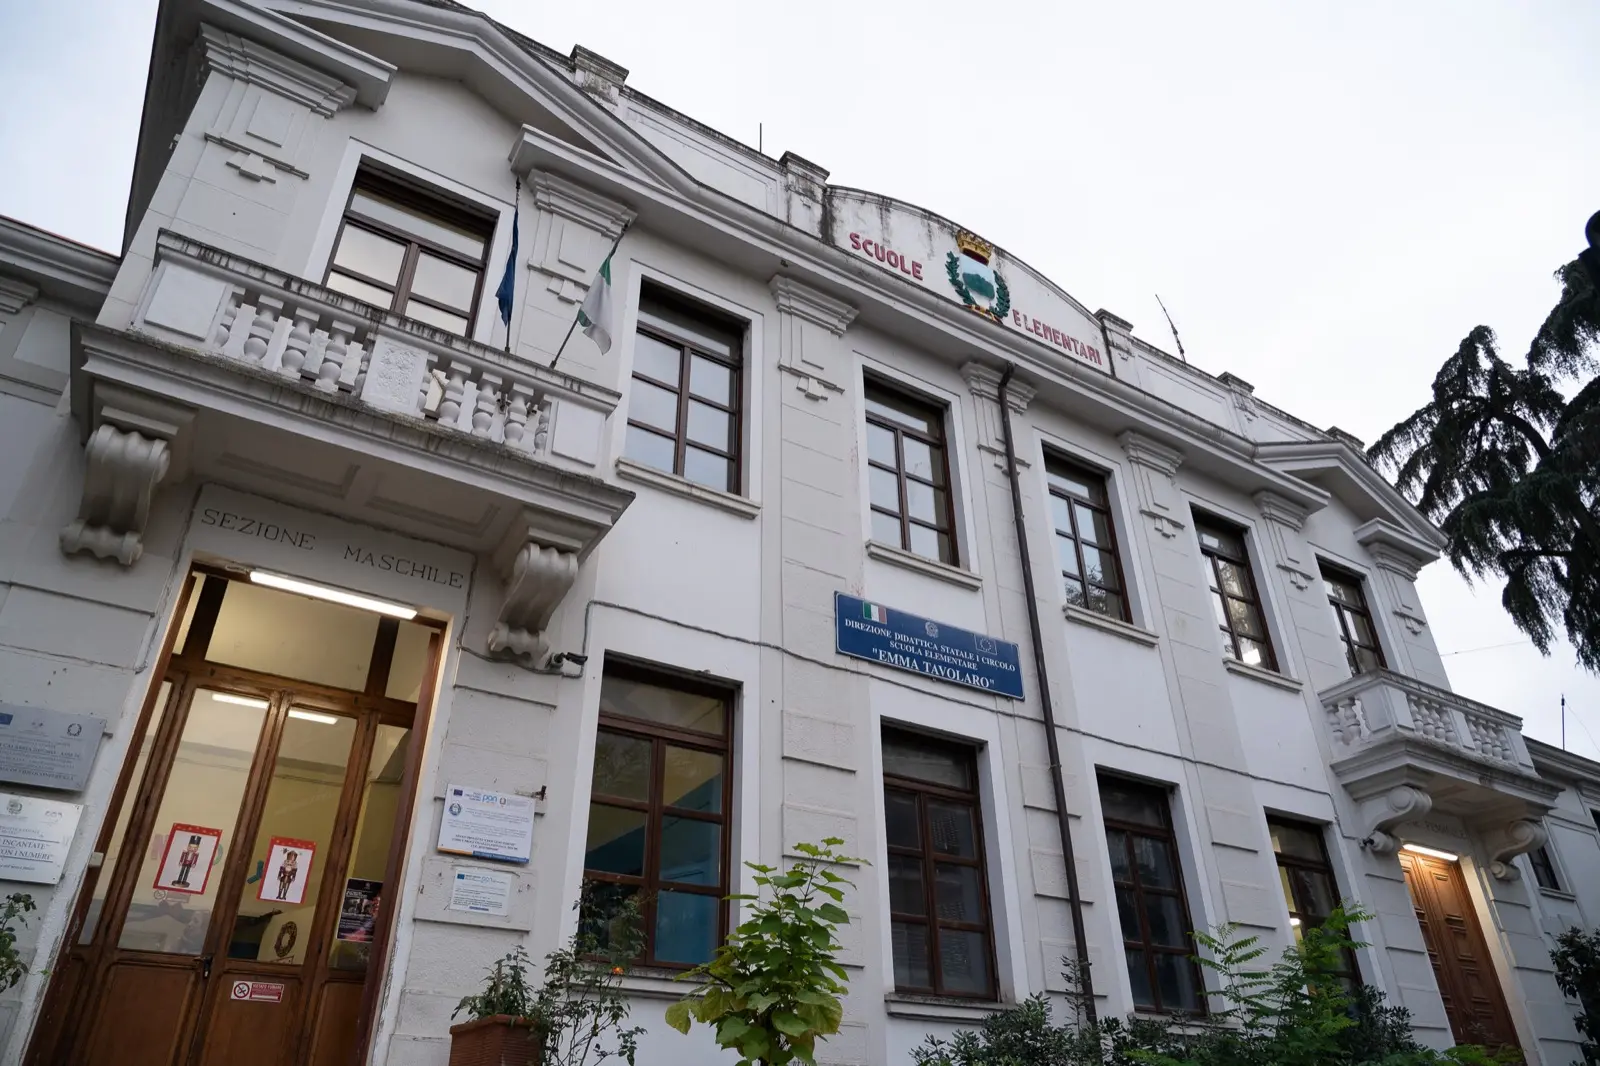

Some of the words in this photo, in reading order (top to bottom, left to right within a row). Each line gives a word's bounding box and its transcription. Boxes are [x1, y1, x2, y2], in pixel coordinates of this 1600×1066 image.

[849, 232, 924, 281] SCUOLE
[1012, 308, 1103, 366] ELEMENTARI
[201, 508, 317, 551] SEZIONE
[343, 544, 464, 589] MASCHILE
[845, 618, 892, 638] DIREZIONE
[894, 632, 938, 650] DIDATTICA
[940, 644, 975, 661] STATALE
[981, 656, 1016, 672] CIRCOLO
[872, 647, 920, 671] "EMMA
[922, 661, 995, 688] TAVOLARO"
[889, 640, 923, 656] SCUOLA
[924, 649, 978, 671] ELEMENTARE
